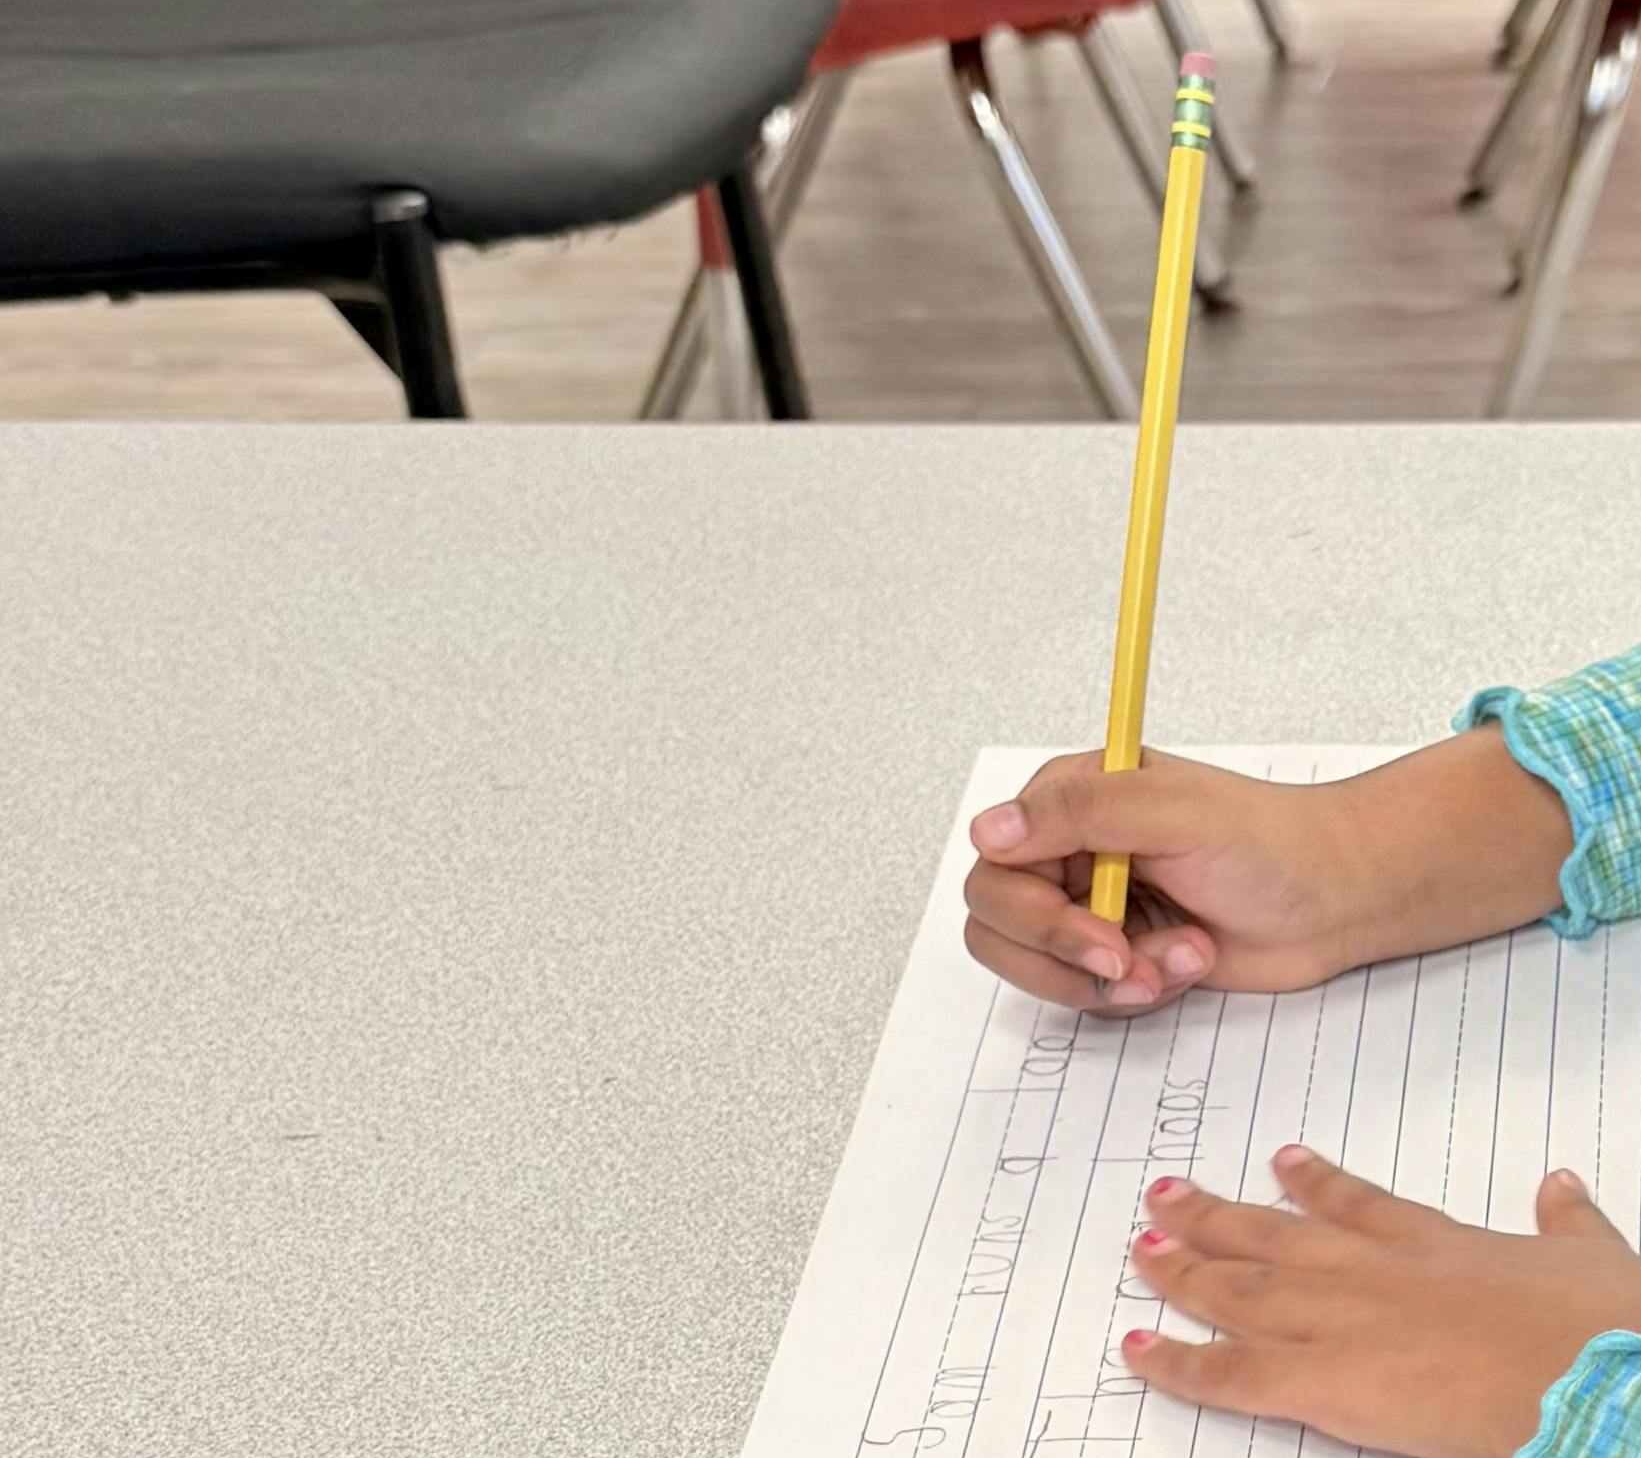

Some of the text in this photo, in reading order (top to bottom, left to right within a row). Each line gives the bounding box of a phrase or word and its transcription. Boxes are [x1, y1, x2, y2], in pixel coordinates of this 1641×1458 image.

[862, 1034, 1094, 1449] Sam runs a lap
[1091, 1078, 1230, 1162] hops
